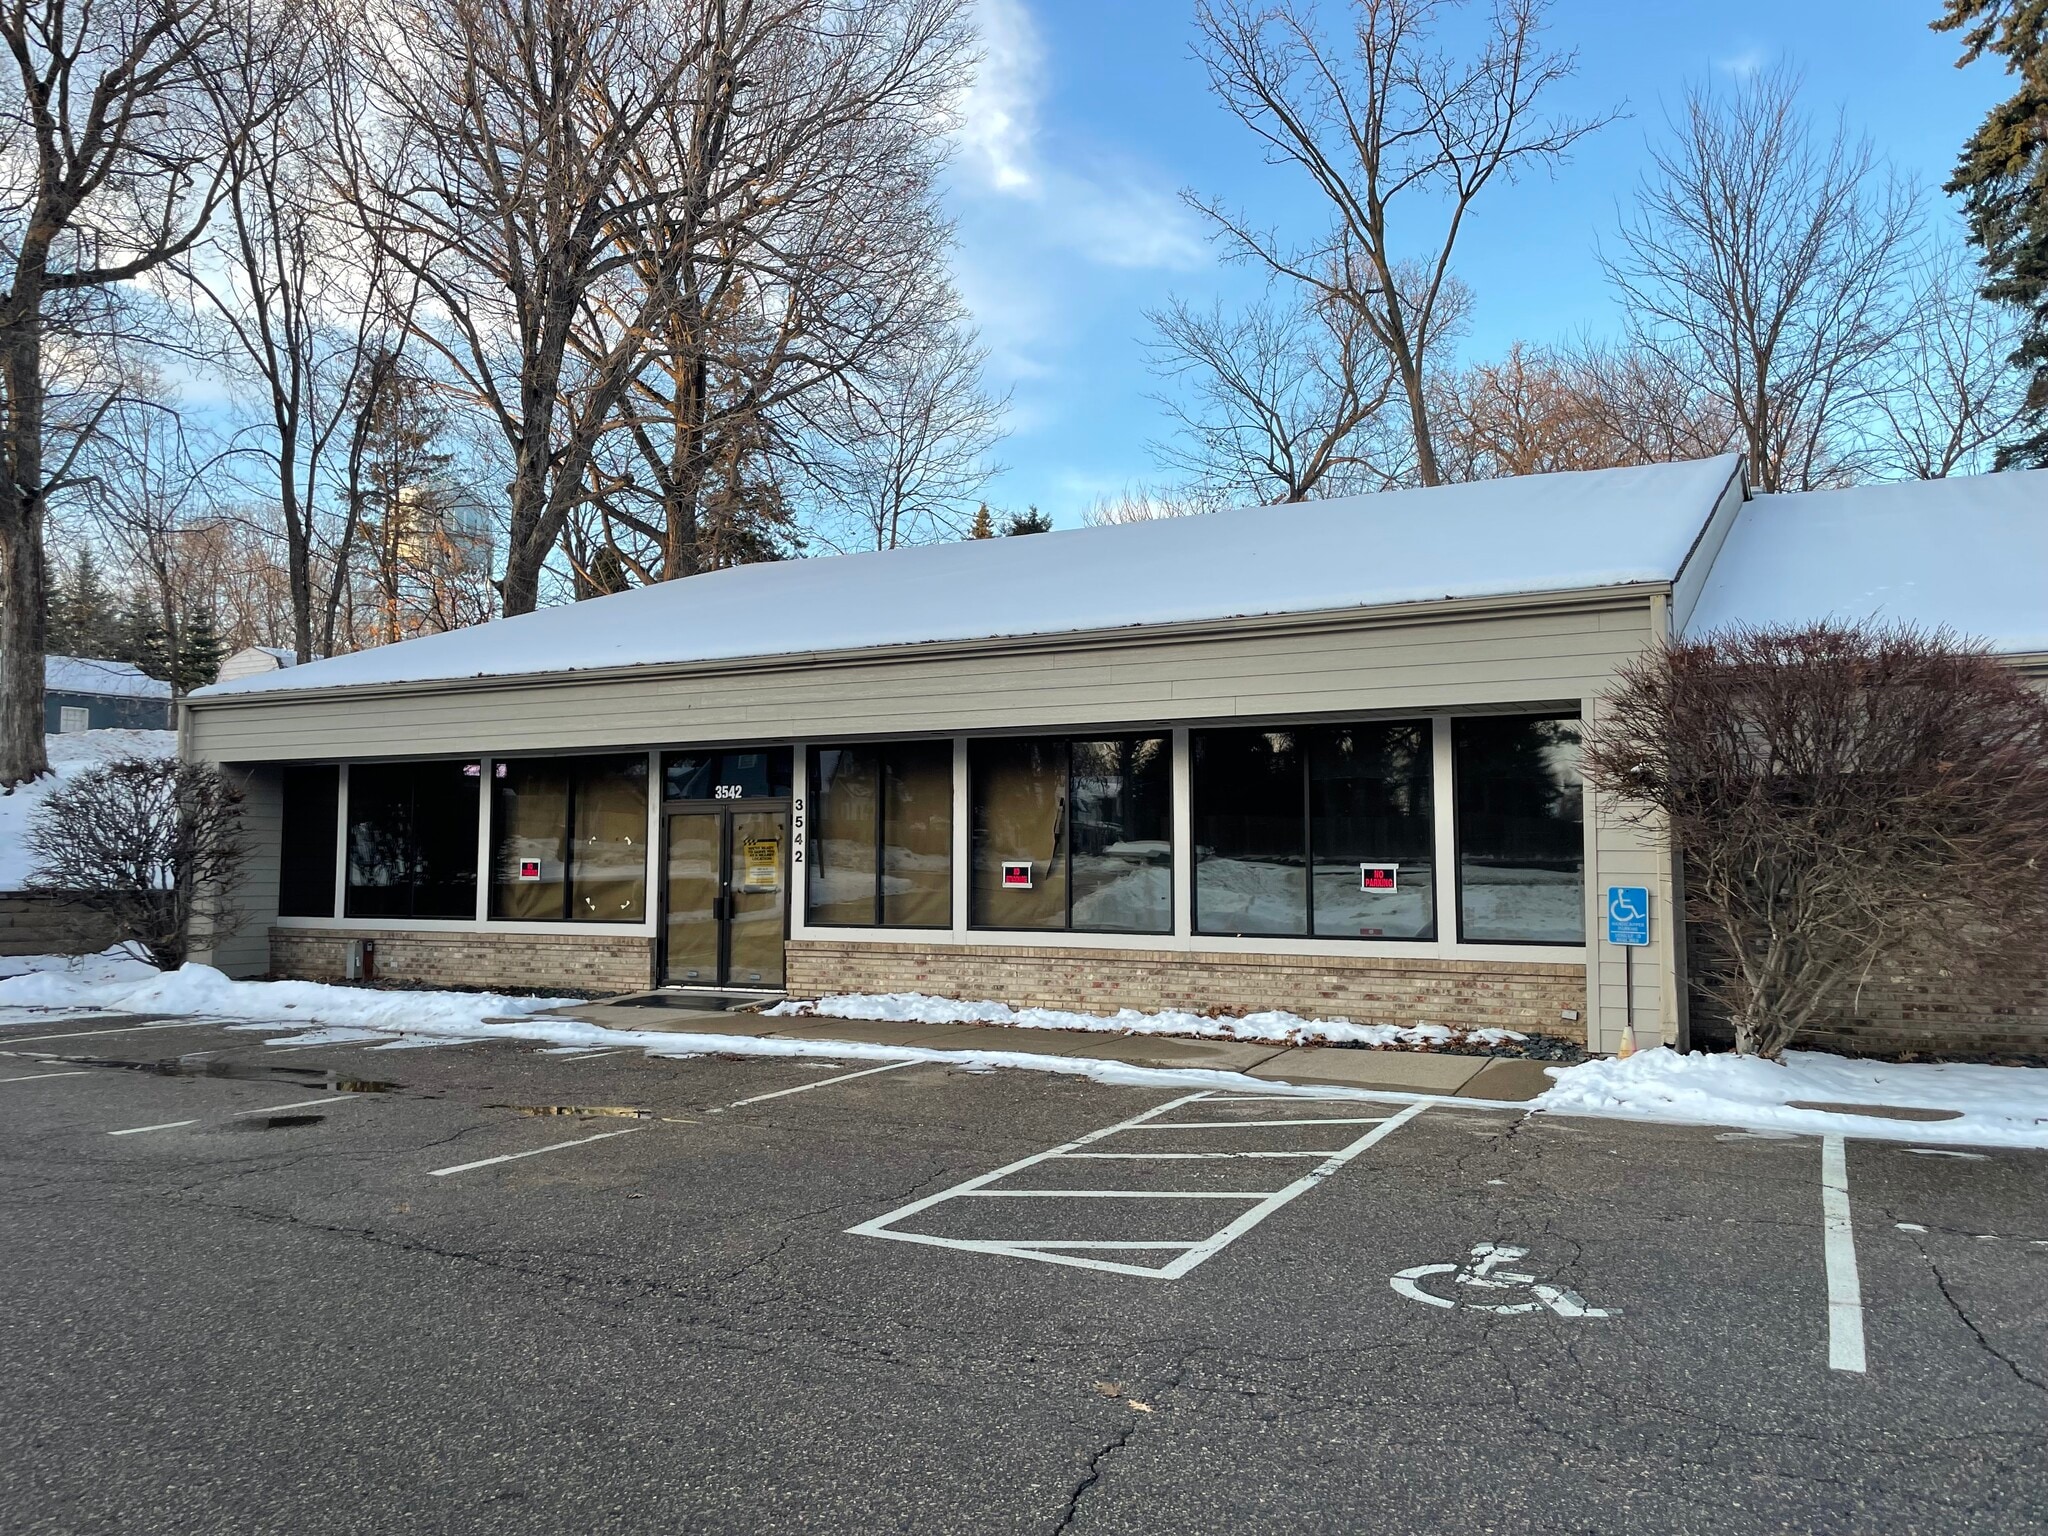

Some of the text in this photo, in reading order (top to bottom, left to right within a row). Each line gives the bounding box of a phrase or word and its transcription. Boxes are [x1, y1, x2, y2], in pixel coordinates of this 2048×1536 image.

[715, 785, 742, 799] 3542
[795, 799, 803, 862] 3542
[1374, 870, 1383, 878] NO
[1366, 879, 1393, 887] PARKING
